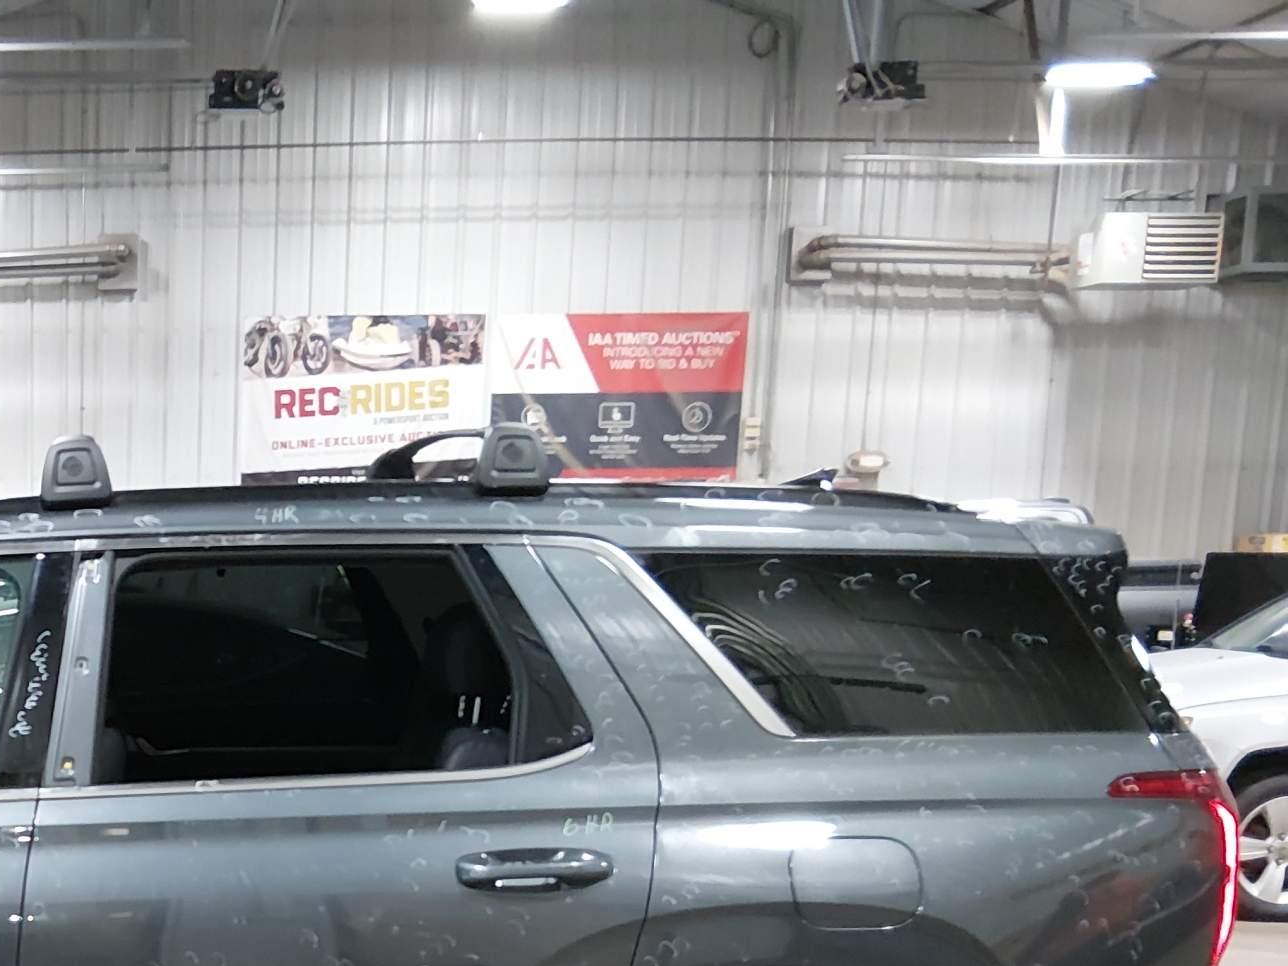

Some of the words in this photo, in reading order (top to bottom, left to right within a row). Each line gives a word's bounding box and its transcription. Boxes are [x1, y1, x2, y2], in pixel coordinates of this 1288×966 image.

[588, 332, 614, 346] IAA
[615, 332, 658, 345] TIMED
[602, 346, 682, 358] INTRODUCING
[684, 346, 695, 357] A
[696, 346, 726, 357] NEW
[609, 358, 636, 370] WAY
[638, 358, 655, 370] TO
[690, 358, 716, 370] BUY
[274, 386, 341, 420] REC
[349, 379, 450, 416] RIDES
[271, 434, 395, 451] ONLINE-EXCLUSIVE
